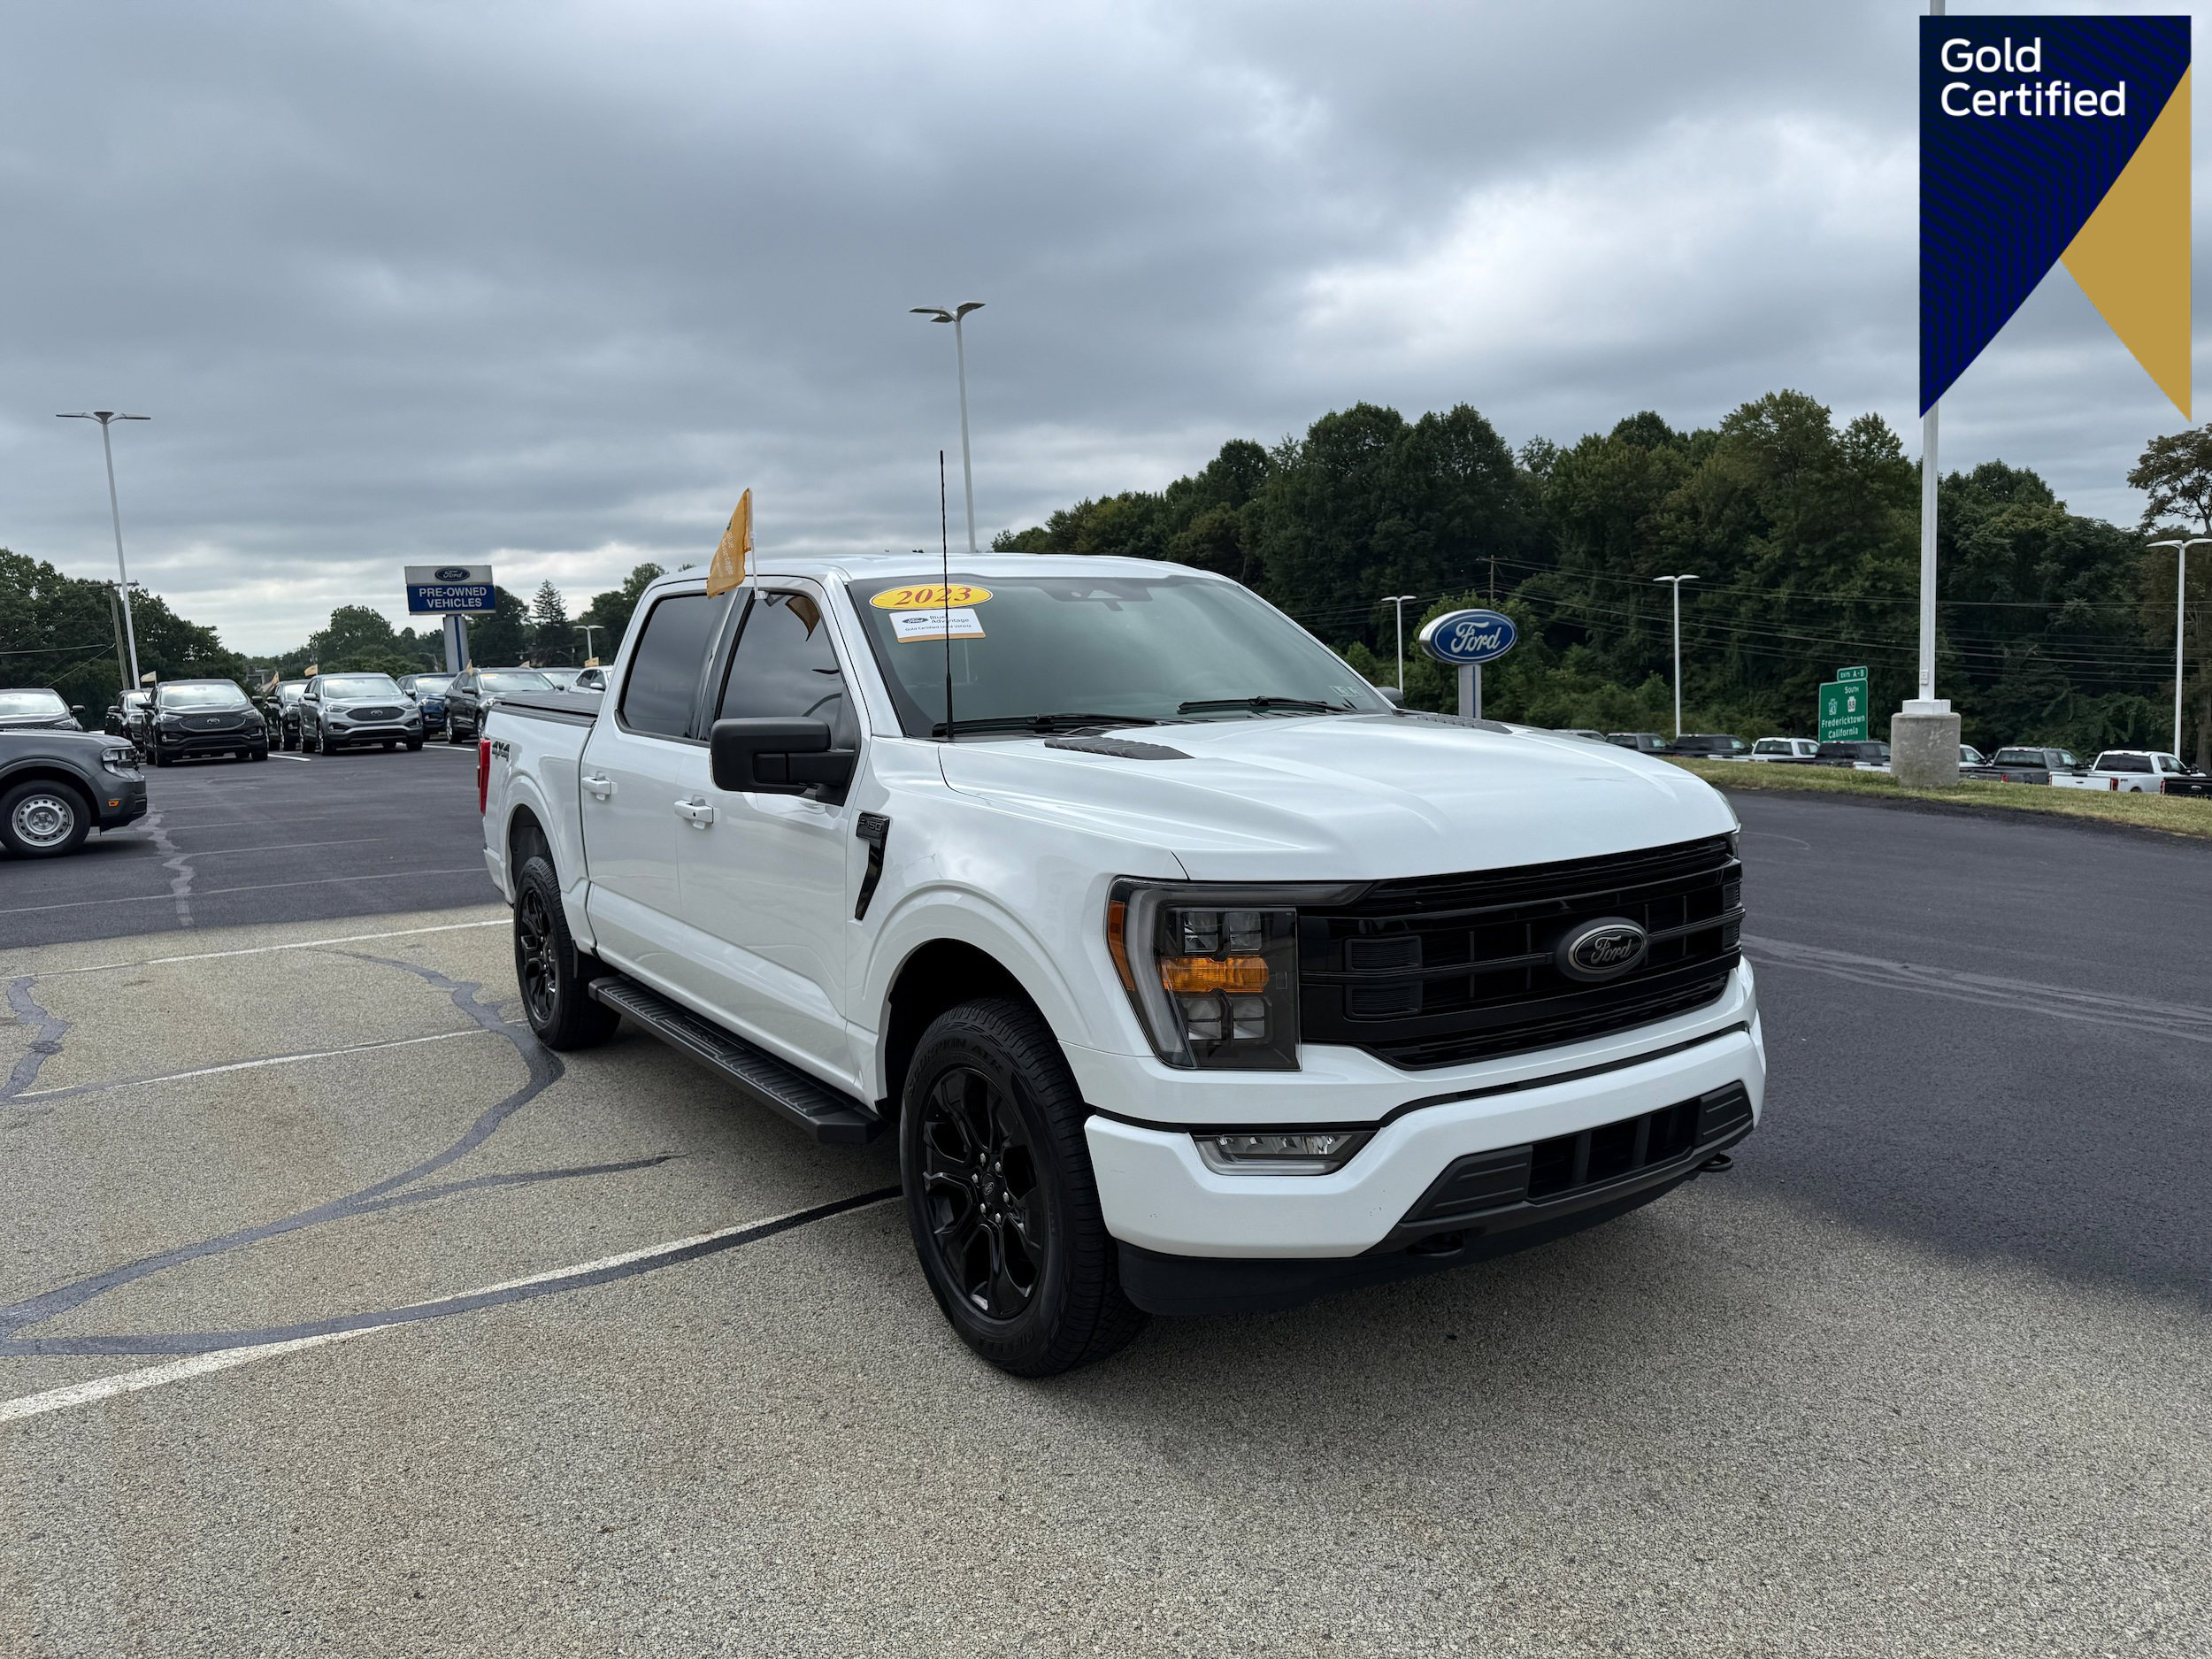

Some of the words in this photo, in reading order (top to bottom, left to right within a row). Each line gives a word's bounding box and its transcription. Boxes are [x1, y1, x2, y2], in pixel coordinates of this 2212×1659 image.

[442, 570, 463, 579] Ford
[419, 587, 487, 597] PRE-OWNED
[894, 587, 972, 606] 2023
[426, 597, 482, 609] VEHICLES
[1450, 621, 1502, 653] Ford
[1822, 715, 1865, 728] Fredericktown
[1828, 726, 1859, 739] California
[1590, 935, 1632, 964] Ford
